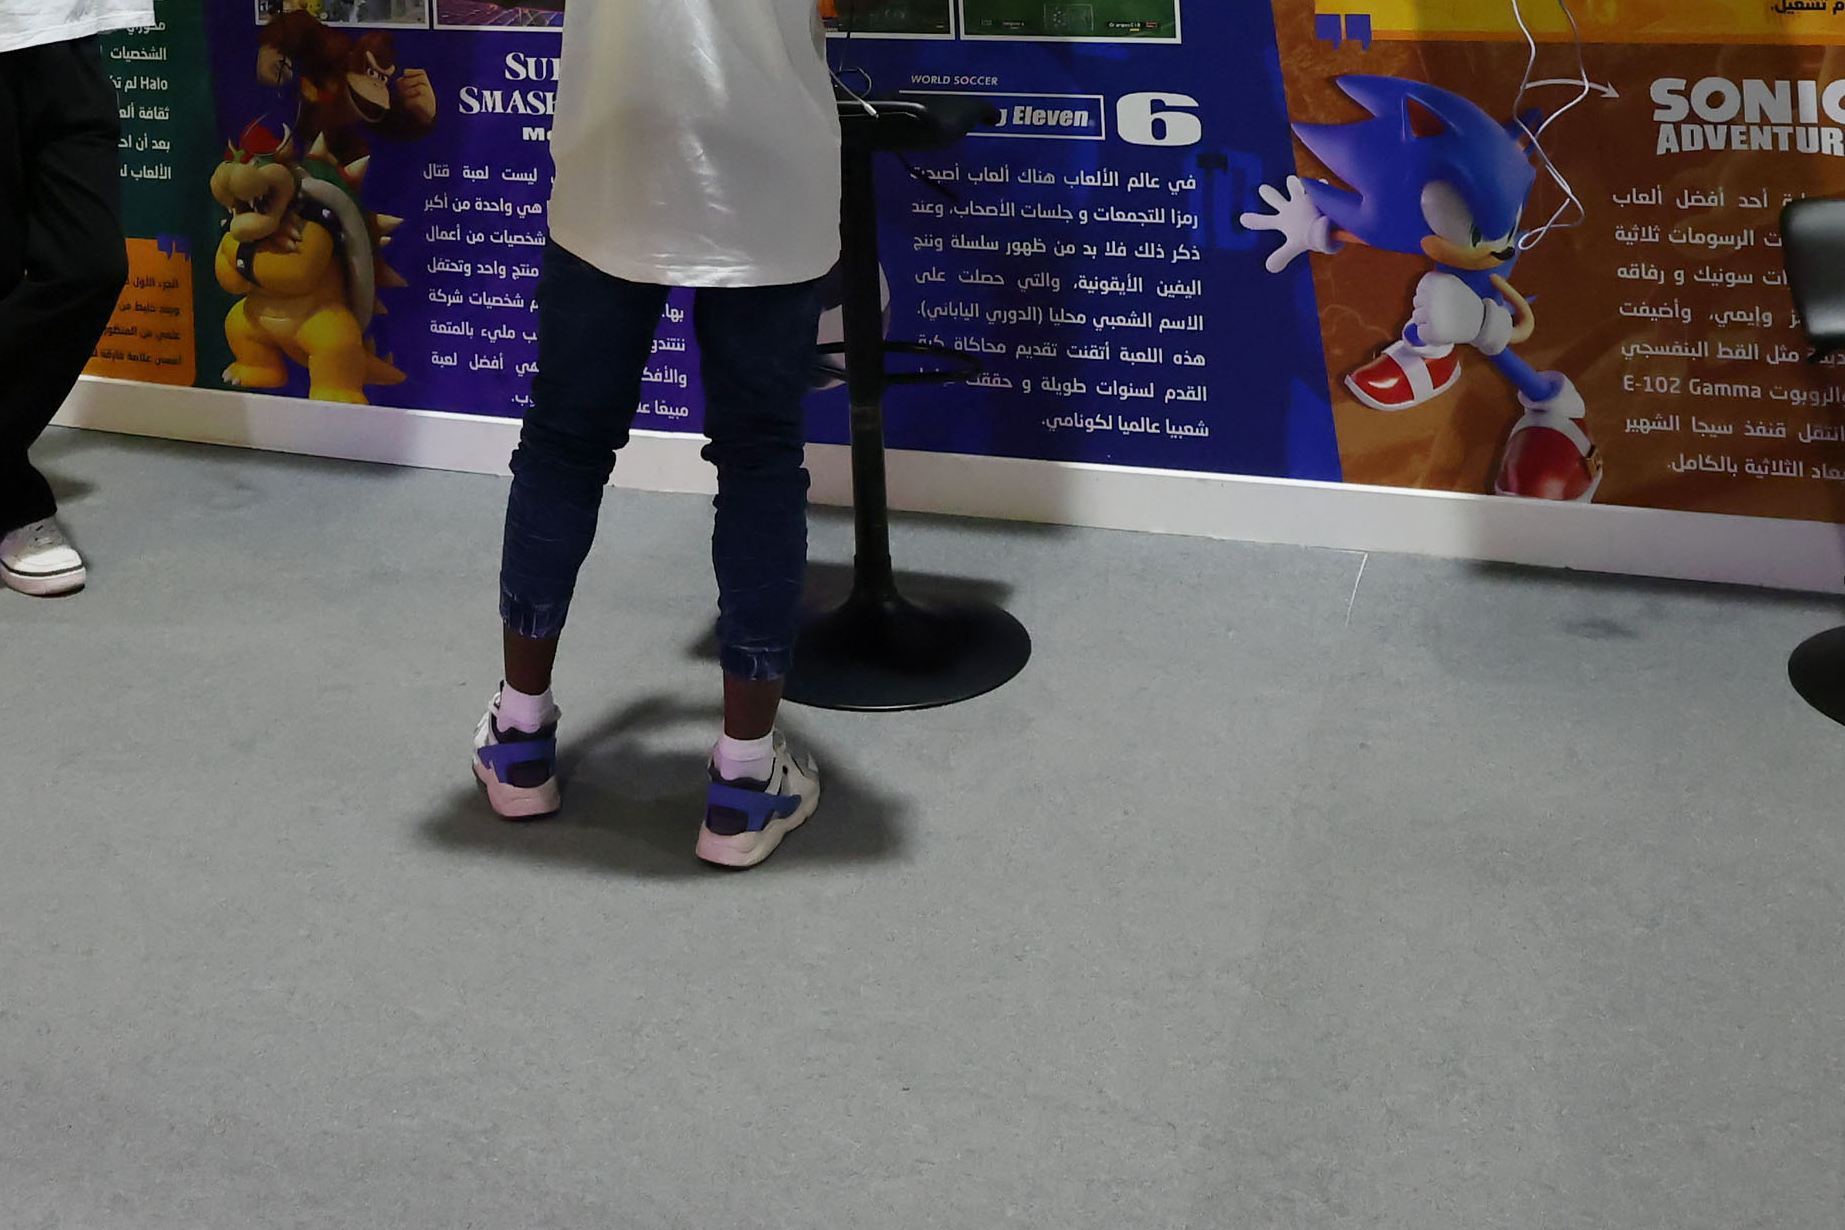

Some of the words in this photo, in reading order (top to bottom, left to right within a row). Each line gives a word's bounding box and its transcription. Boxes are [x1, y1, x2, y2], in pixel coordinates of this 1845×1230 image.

[140, 76, 168, 91] Halo
[910, 73, 951, 86] WORLD
[954, 74, 999, 87] SOCCER
[1012, 105, 1090, 129] Eleven
[1115, 91, 1203, 147] 6
[423, 162, 449, 180] قتال
[462, 164, 488, 182] لعبة
[501, 166, 537, 185] ليست
[1624, 374, 1680, 394] E-102
[1689, 378, 1761, 398] Gamma
[1040, 411, 1112, 433] لكونامي.
[1118, 414, 1160, 435] عالميا
[1165, 417, 1208, 439] شعبيا
[1667, 451, 1737, 477] بالكامل.
[1744, 456, 1803, 479] الثلاثية
